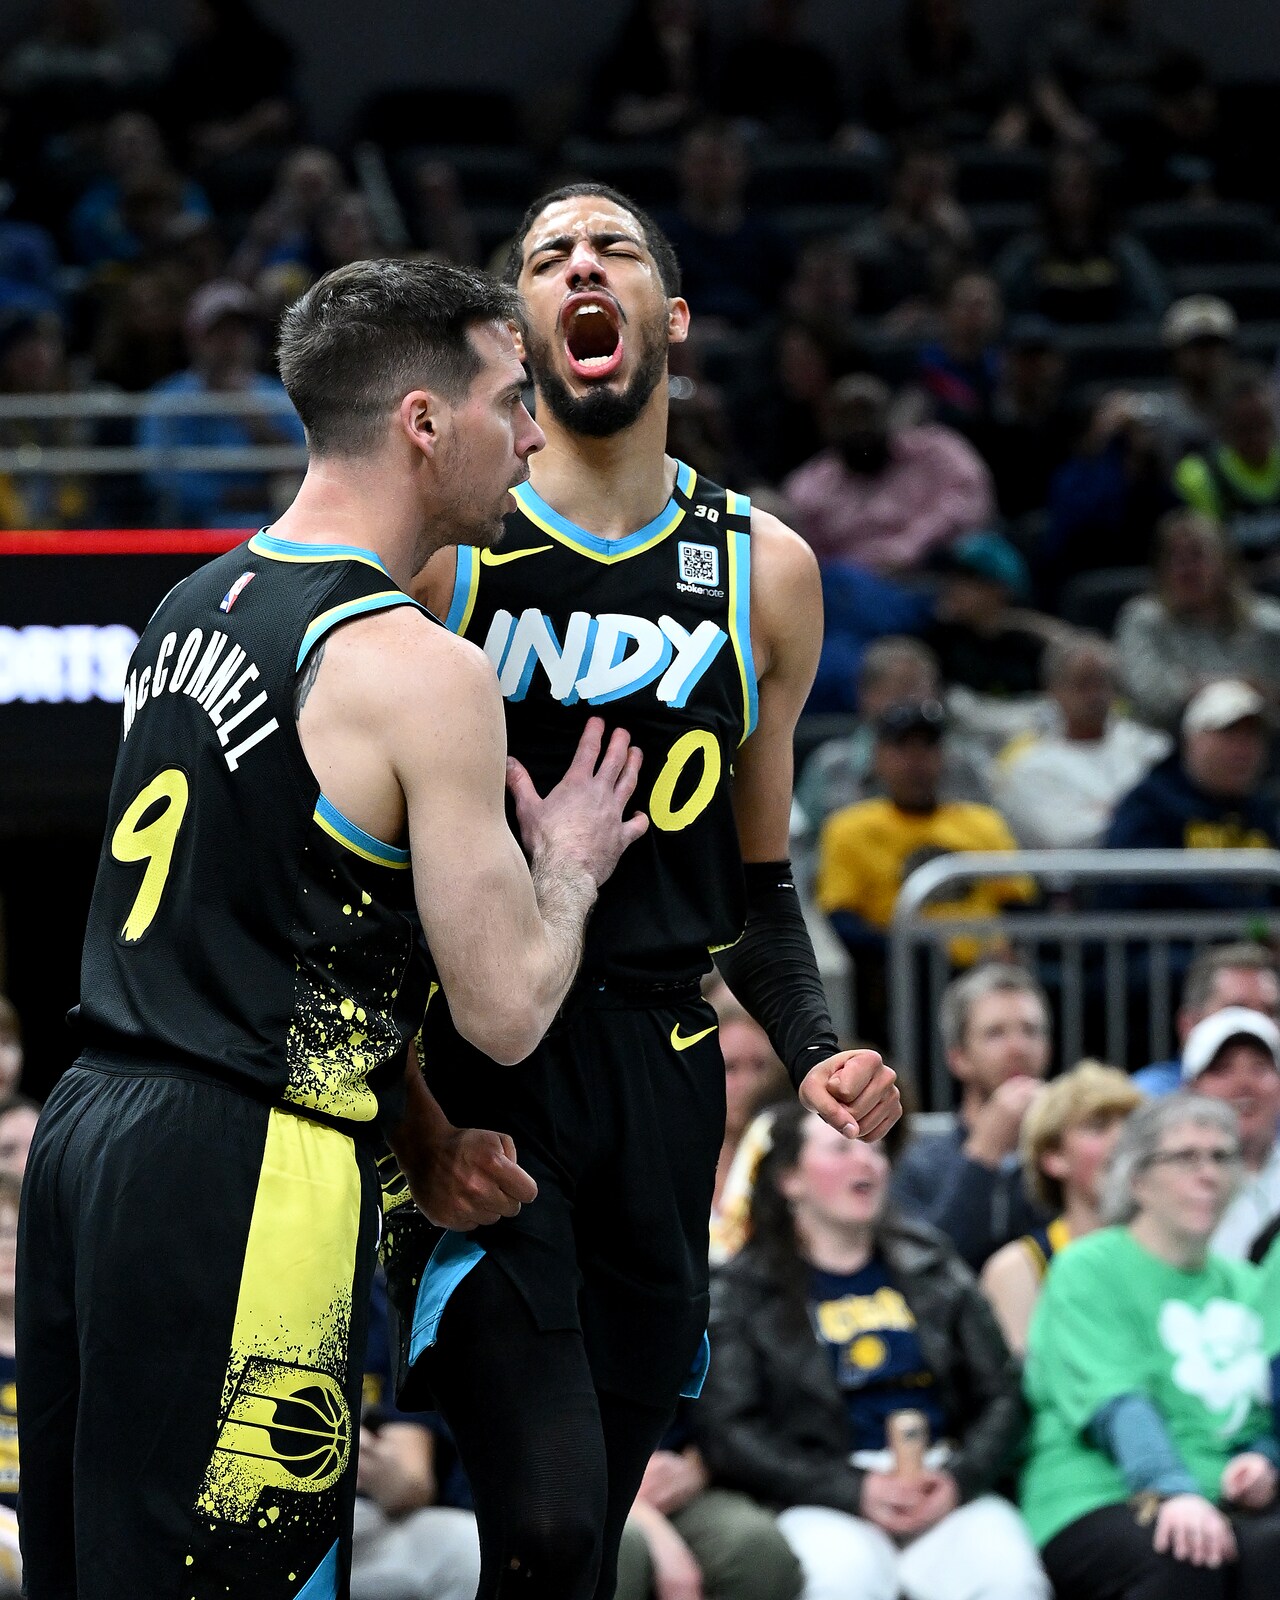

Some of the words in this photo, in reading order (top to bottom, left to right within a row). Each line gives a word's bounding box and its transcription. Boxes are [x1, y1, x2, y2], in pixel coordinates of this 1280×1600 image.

[694, 505, 720, 523] 30
[676, 582, 725, 598] spokenote
[483, 608, 728, 708] INDY
[649, 729, 721, 832] 0
[111, 768, 189, 942] 9
